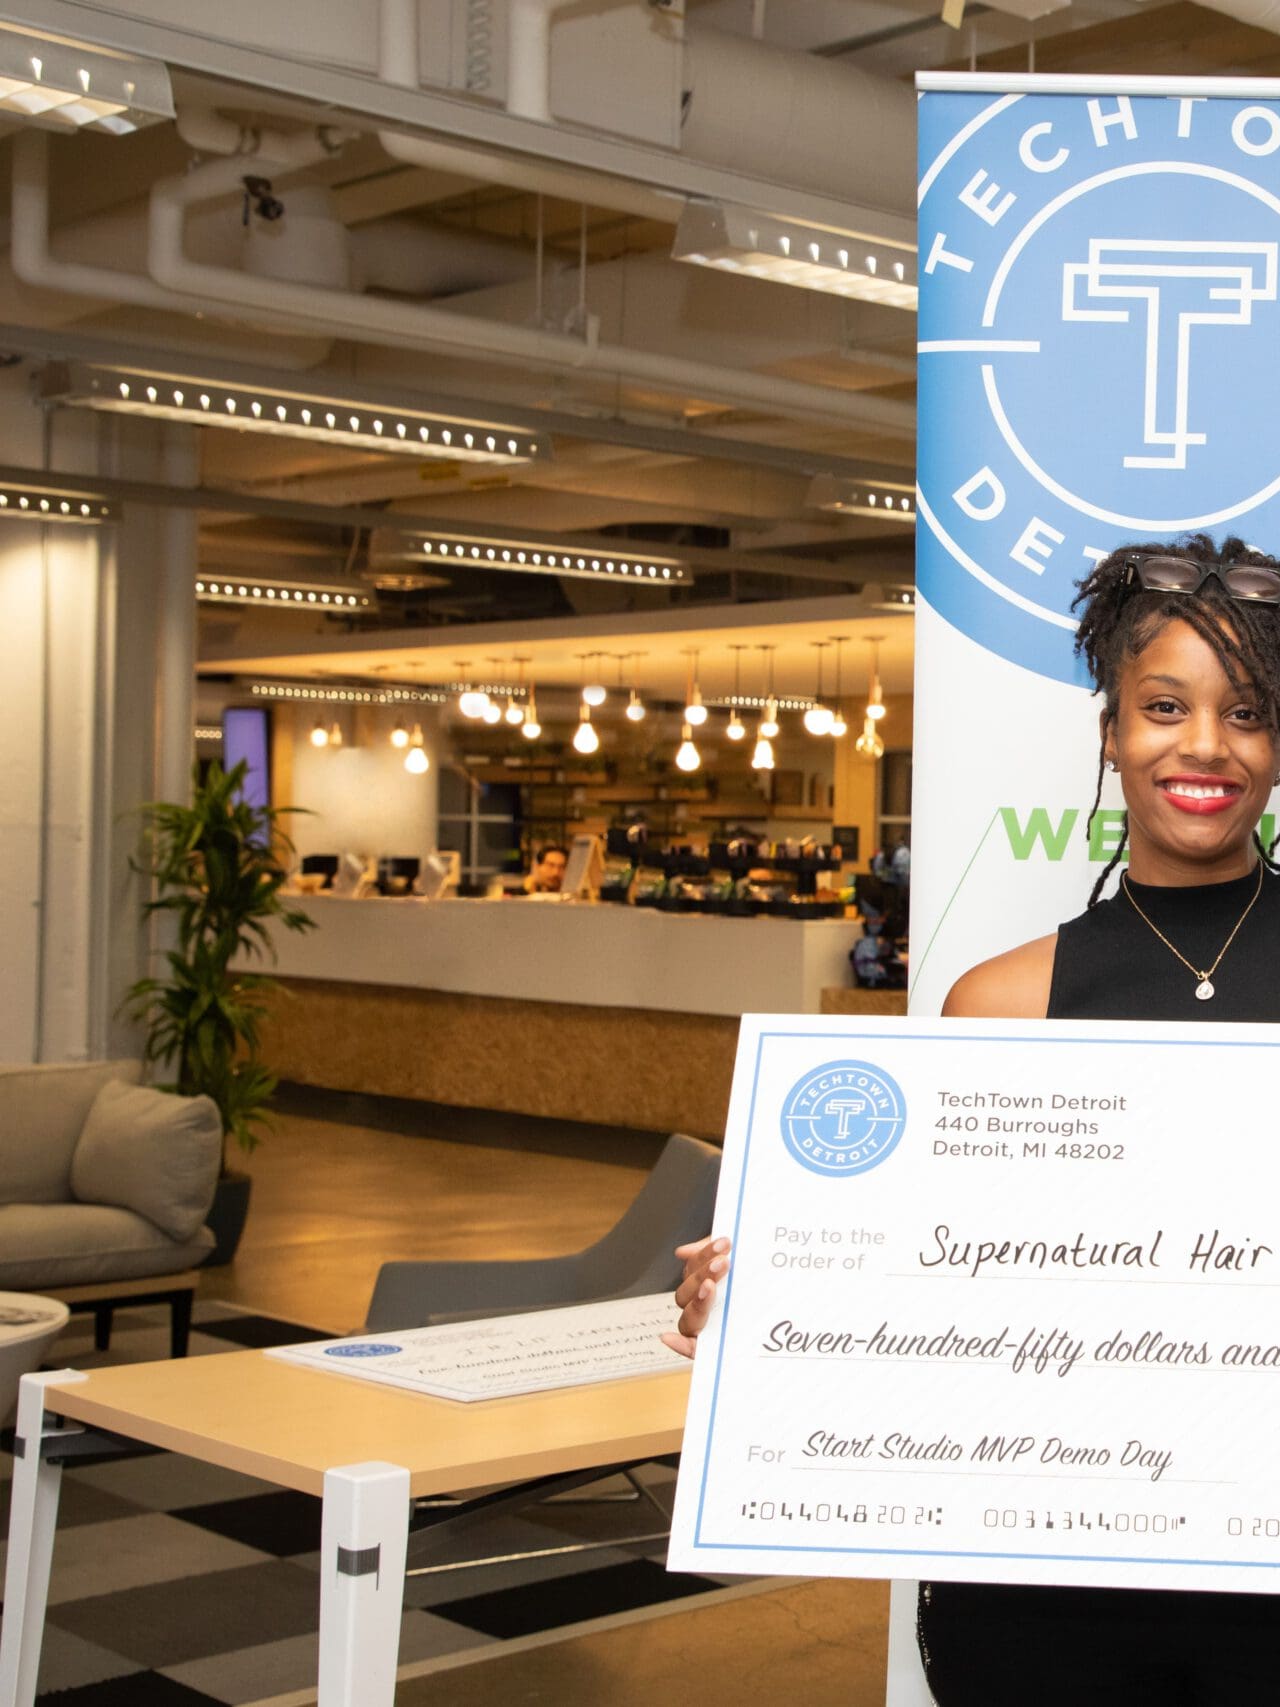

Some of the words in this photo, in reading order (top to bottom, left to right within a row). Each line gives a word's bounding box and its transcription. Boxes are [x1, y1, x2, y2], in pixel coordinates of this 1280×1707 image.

[1001, 807, 1129, 862] WE
[800, 1074, 890, 1109] TECHTOWN
[937, 1091, 1043, 1109] TechTown
[1051, 1094, 1127, 1111] Detroit
[935, 1116, 979, 1132] 440
[987, 1117, 1099, 1137] Burroughs
[802, 1138, 878, 1163] DETROIT
[933, 1140, 1014, 1160] Detroit,
[1023, 1142, 1046, 1158] MI
[1055, 1143, 1125, 1160] 48202
[773, 1226, 813, 1246] Pay
[821, 1228, 843, 1244] to
[850, 1229, 886, 1246] the
[770, 1252, 835, 1270] Order
[842, 1253, 865, 1271] of
[919, 1224, 1163, 1278] Supernatural
[1190, 1230, 1273, 1273] Hair
[762, 1319, 1084, 1377] Seven-hundred-fifty
[1094, 1330, 1213, 1367] dollars
[747, 1446, 786, 1464] For
[801, 1430, 875, 1460] Start
[877, 1432, 964, 1464] Studio
[969, 1436, 1036, 1464] MVP
[1039, 1438, 1112, 1468] Demo
[1119, 1440, 1174, 1482] Day
